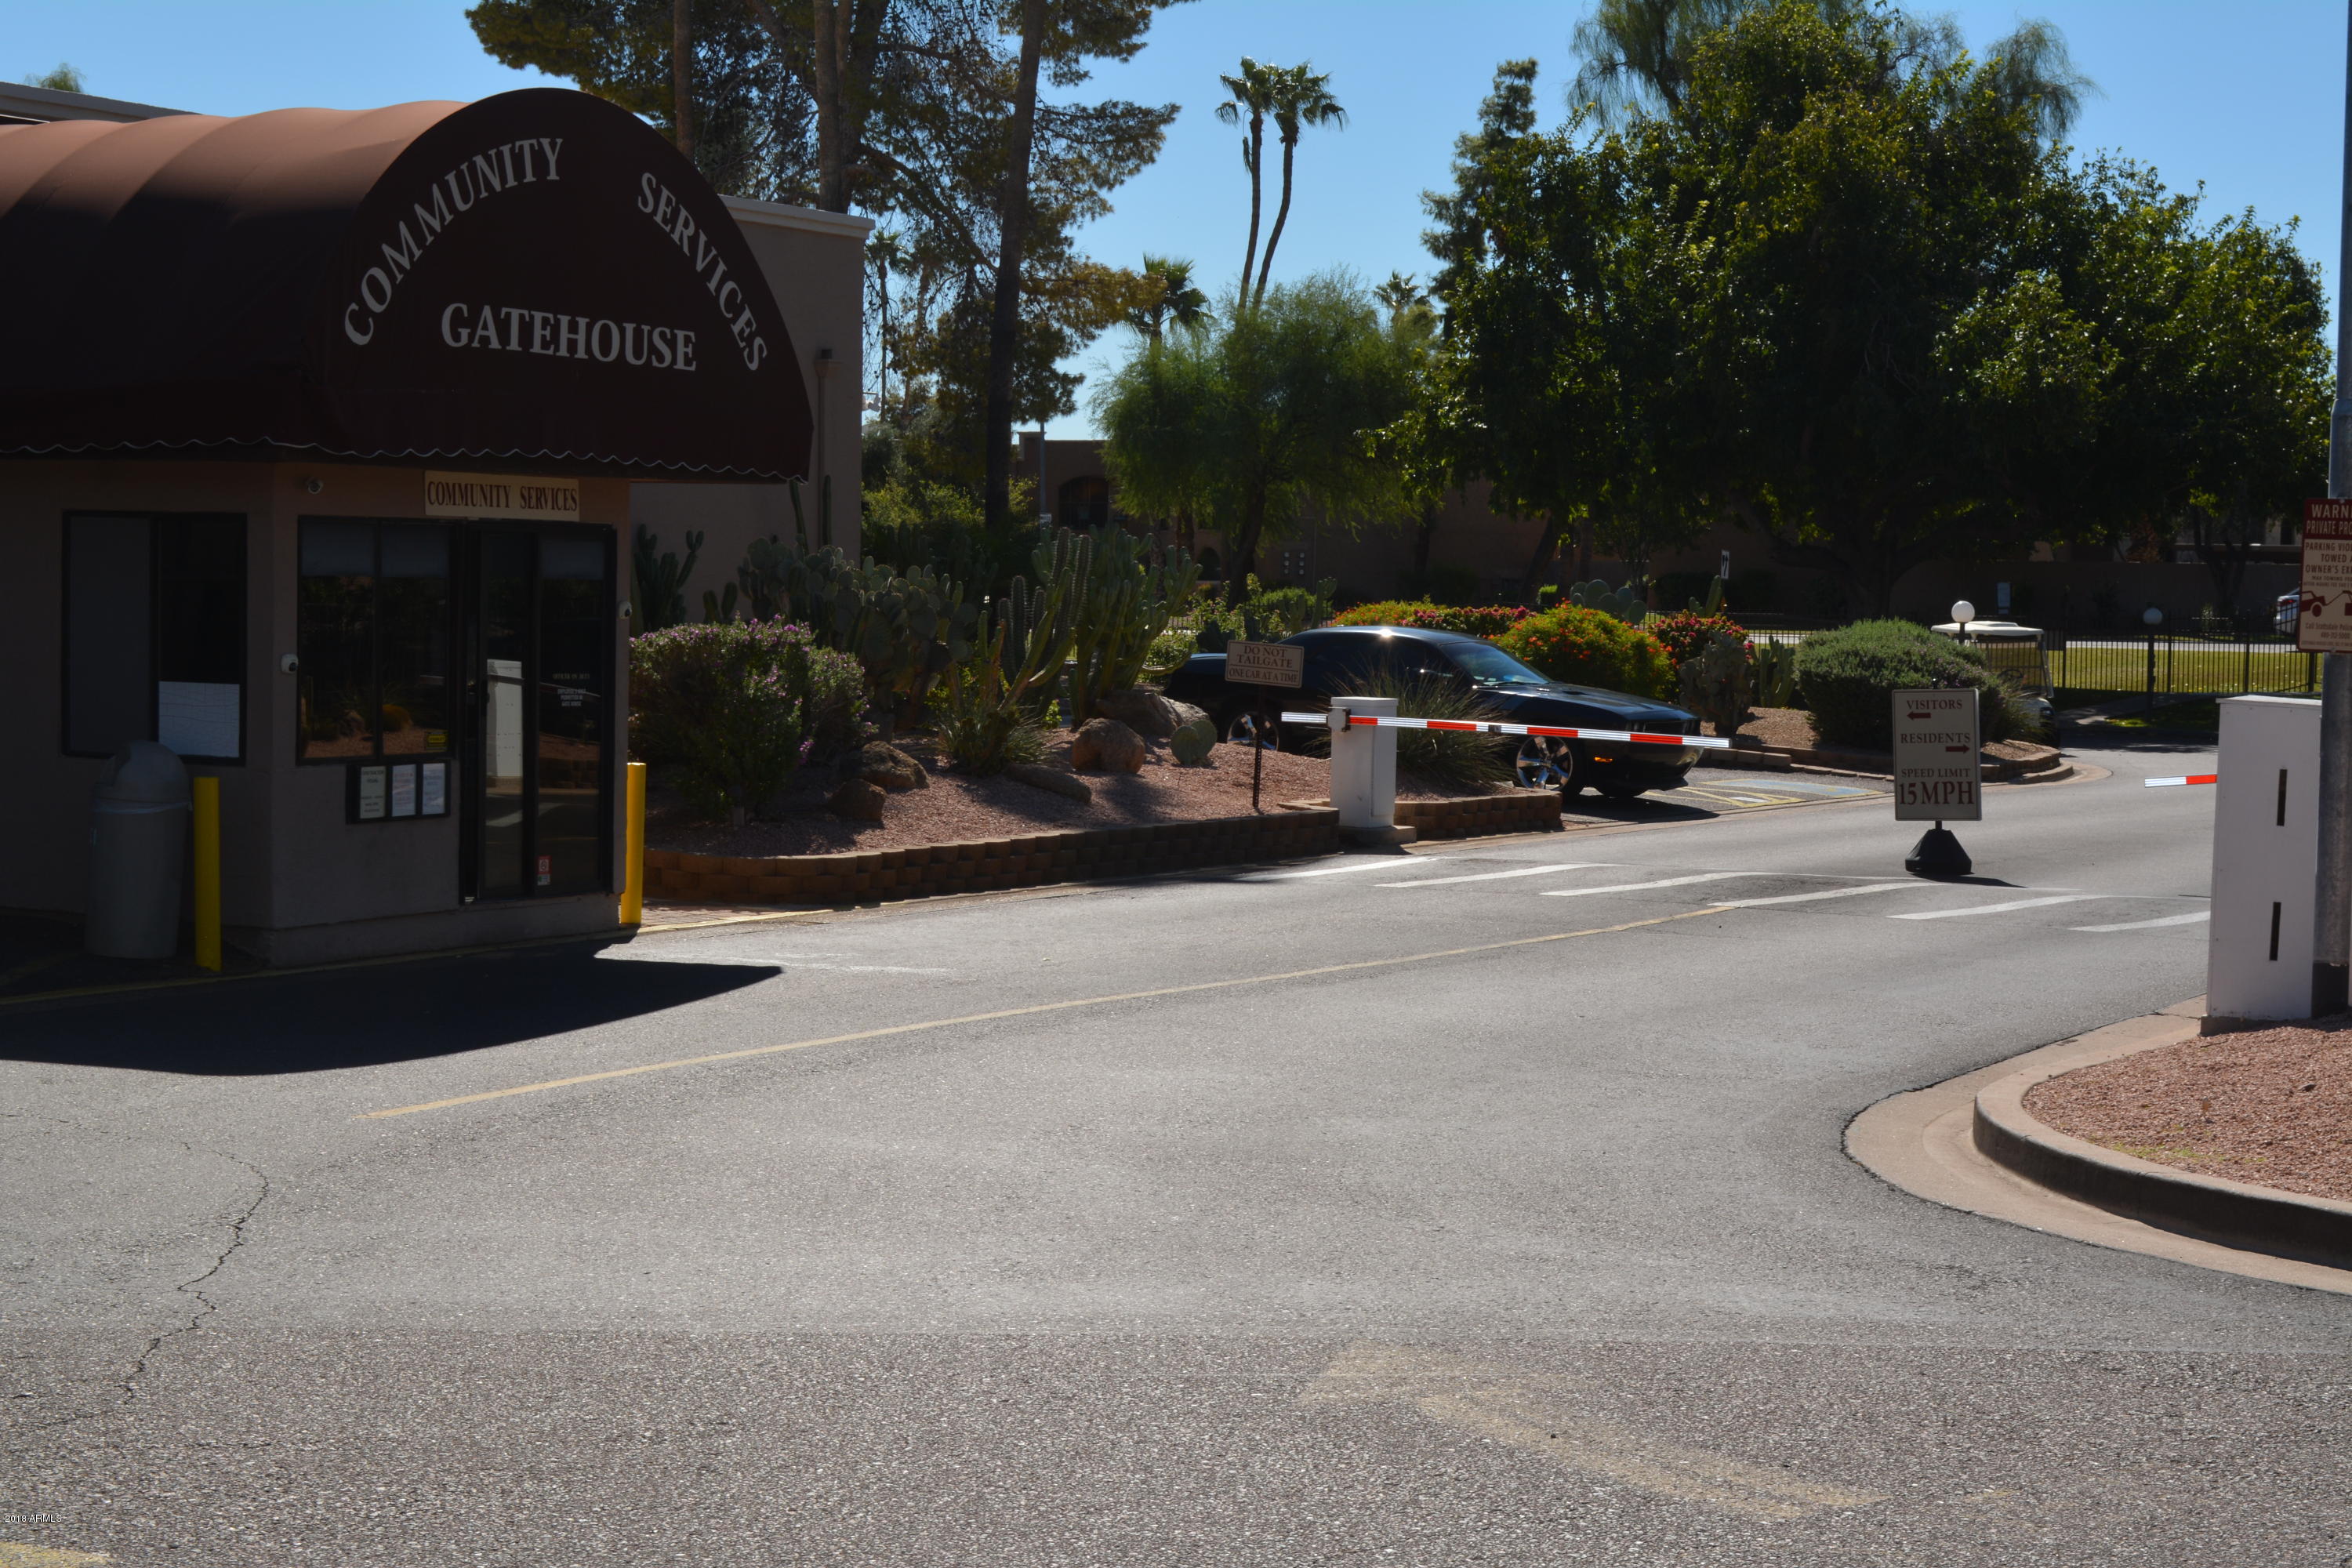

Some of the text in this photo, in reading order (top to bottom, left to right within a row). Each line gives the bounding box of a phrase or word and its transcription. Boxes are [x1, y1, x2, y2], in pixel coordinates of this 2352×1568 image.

[344, 138, 768, 372] COMMUNITY SERVICES
[441, 303, 696, 372] GATEHOUSE
[427, 481, 578, 512] COMMUNITY SERVICES
[2311, 504, 2352, 518] WARN
[2307, 520, 2336, 535] PRIVATE
[2306, 543, 2352, 552] PARKING VIO
[2321, 554, 2347, 563] TOWED
[2306, 564, 2339, 574] OWNER'S
[1244, 645, 1287, 658] DO NOT
[1236, 654, 1293, 668] TAILGATE
[1229, 667, 1298, 683] ONE CAR AT A TIME
[1906, 699, 1963, 710] VISITORS
[1900, 732, 1970, 743] RESIDENTS
[1901, 768, 1970, 778] SPEED LIMIT
[1922, 781, 1975, 804] MPH
